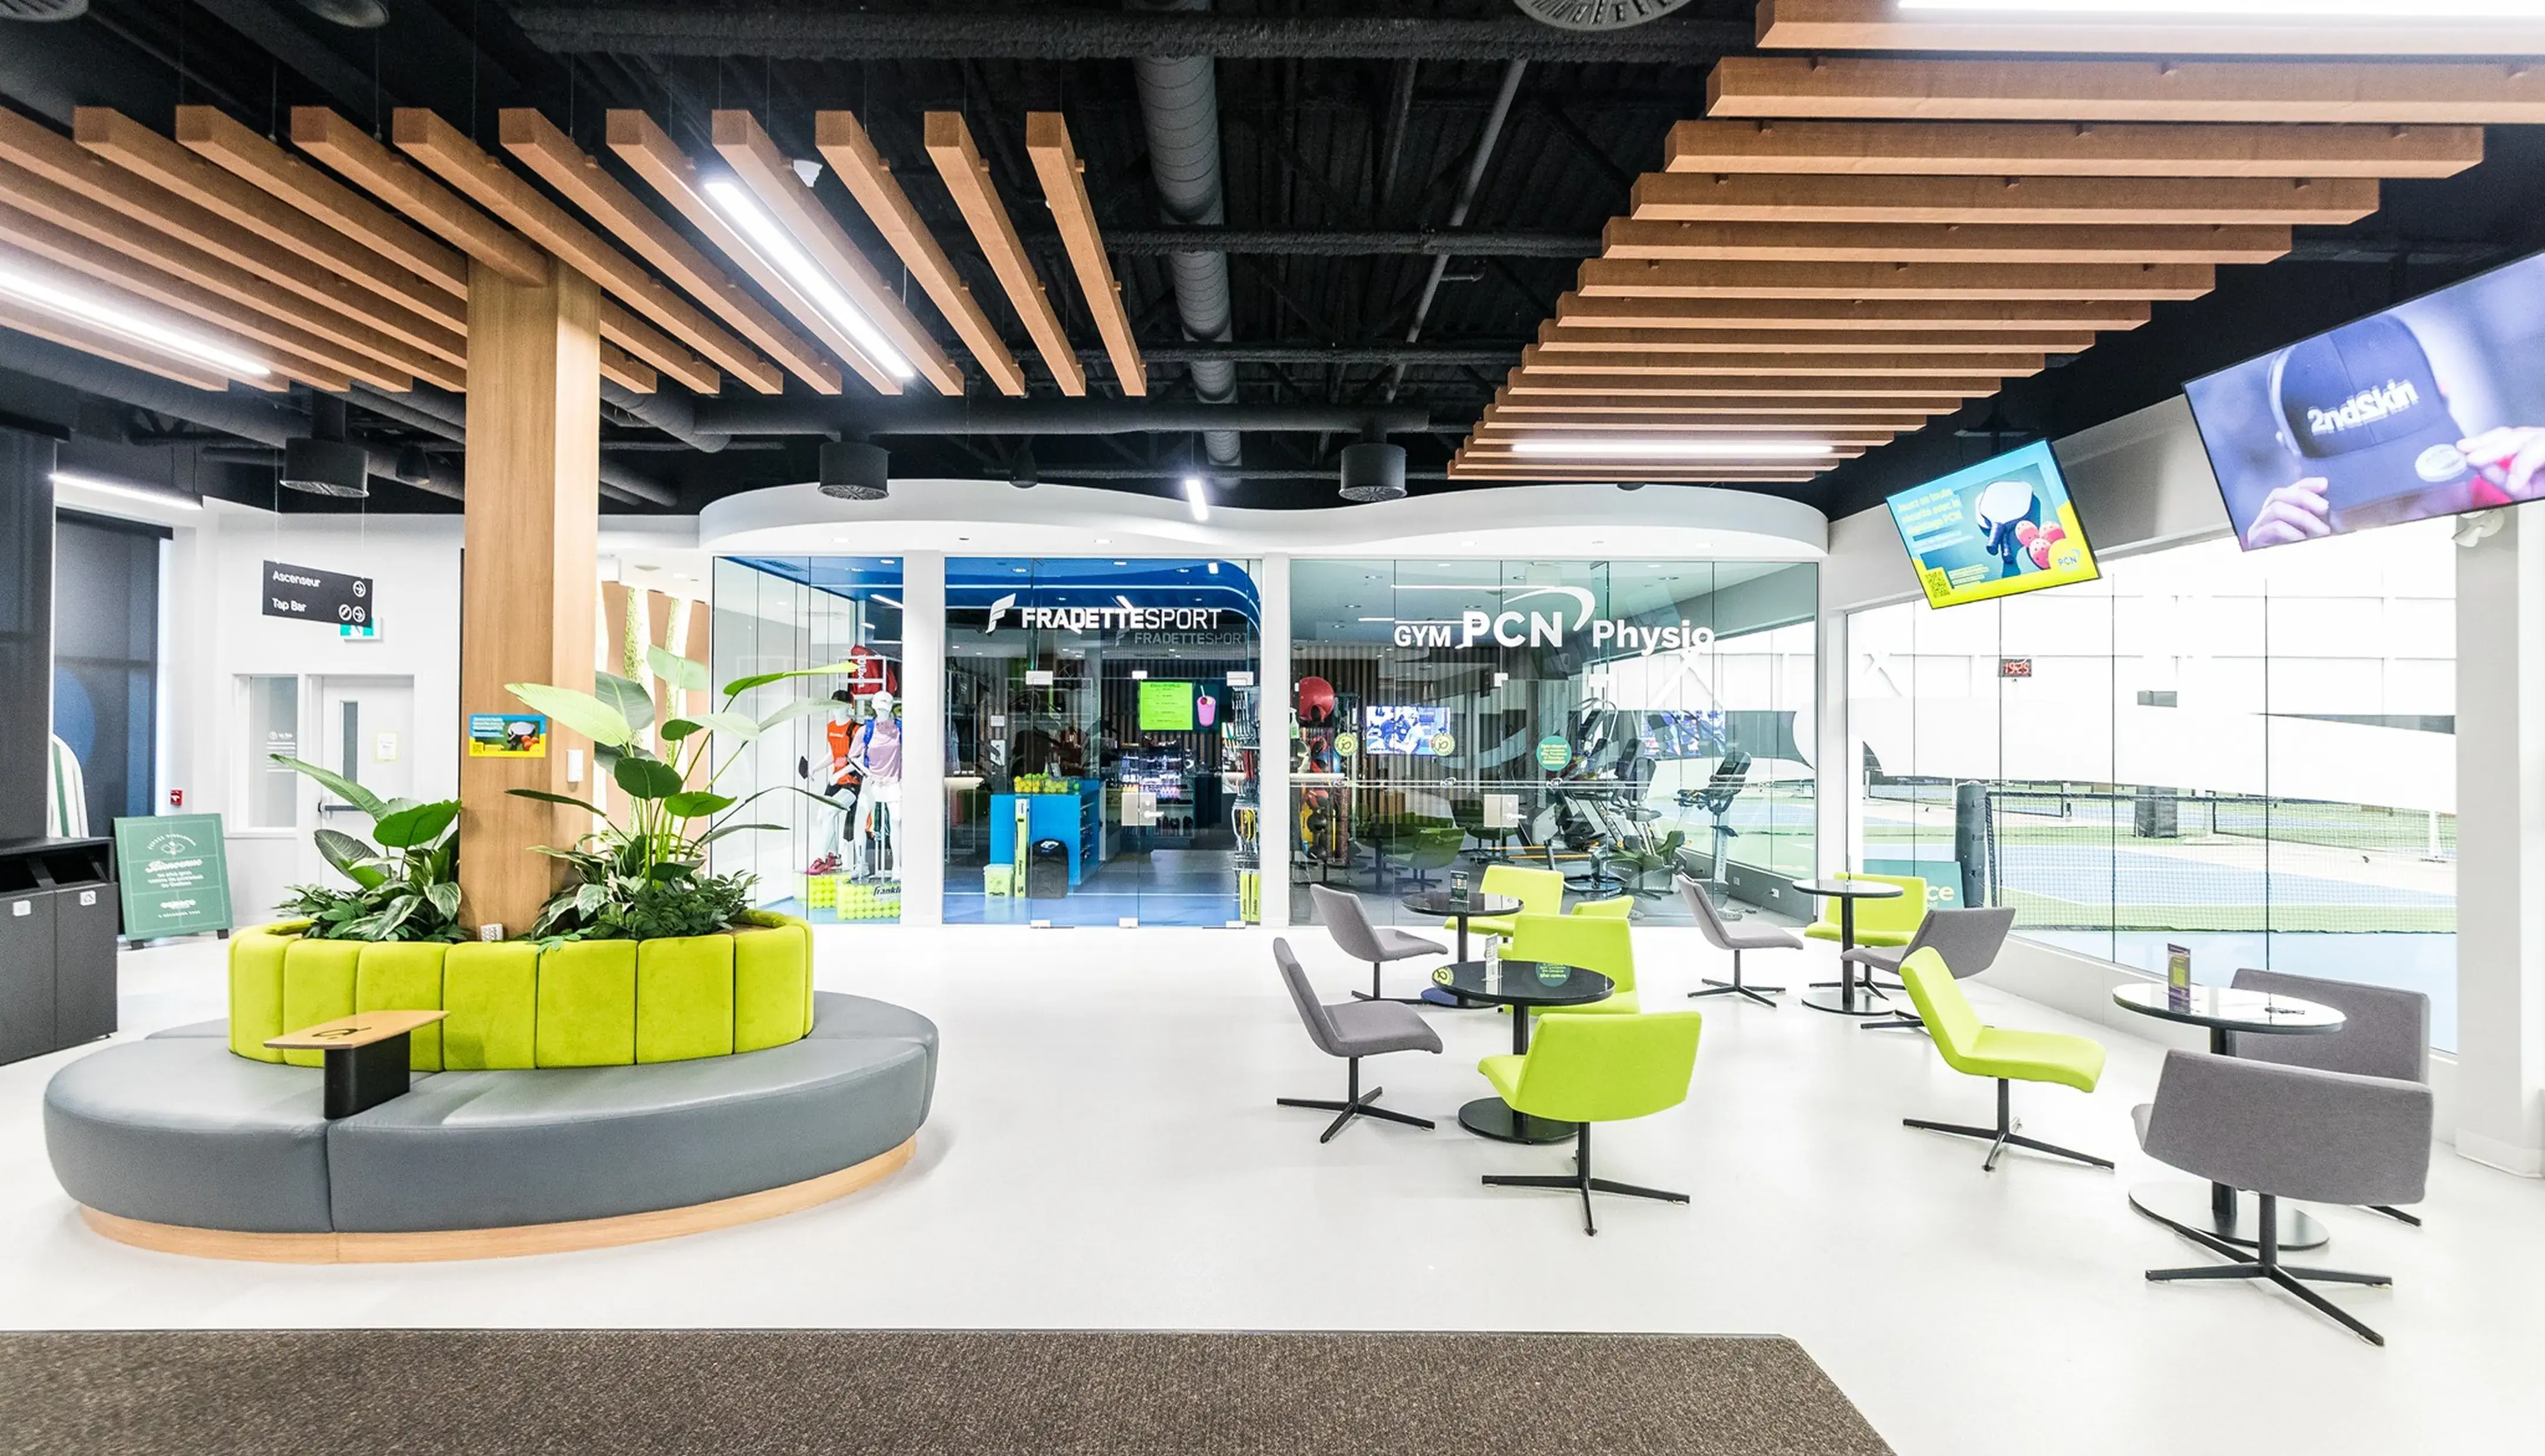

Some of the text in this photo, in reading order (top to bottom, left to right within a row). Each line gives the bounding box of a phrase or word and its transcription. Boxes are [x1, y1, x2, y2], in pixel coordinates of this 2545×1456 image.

[2306, 379, 2420, 436] 2ndSkin
[2057, 555, 2078, 566] PCN
[272, 571, 321, 588] Ascenseur
[272, 597, 307, 613] Tap Bar
[1022, 607, 1222, 630] FRADETTESPORT
[1394, 611, 1715, 656] GYM PCN Physio
[873, 885, 901, 896] frankli
